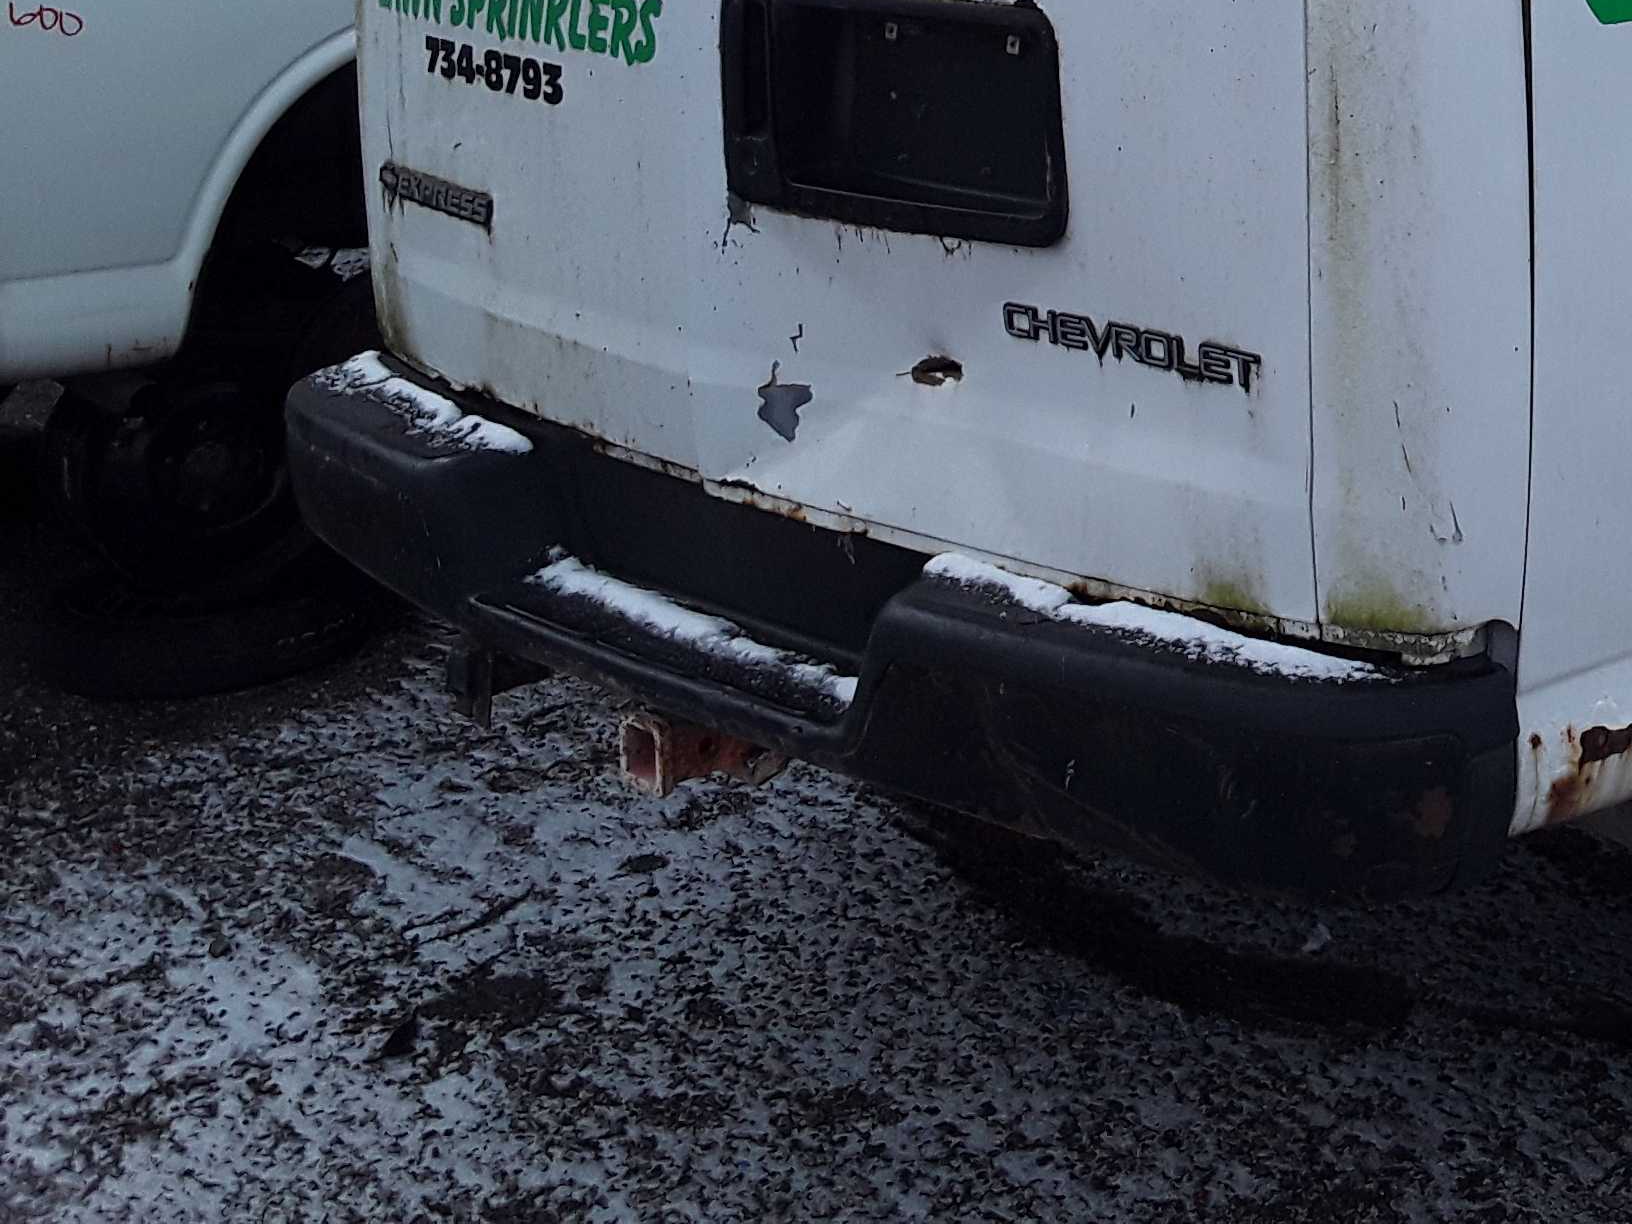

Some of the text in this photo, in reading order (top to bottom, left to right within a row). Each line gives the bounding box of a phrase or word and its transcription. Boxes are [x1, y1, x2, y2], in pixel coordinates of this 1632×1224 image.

[425, 36, 564, 105] 734-8793
[399, 176, 488, 219] EXPRESS
[1003, 302, 1261, 393] CHEVROLET
